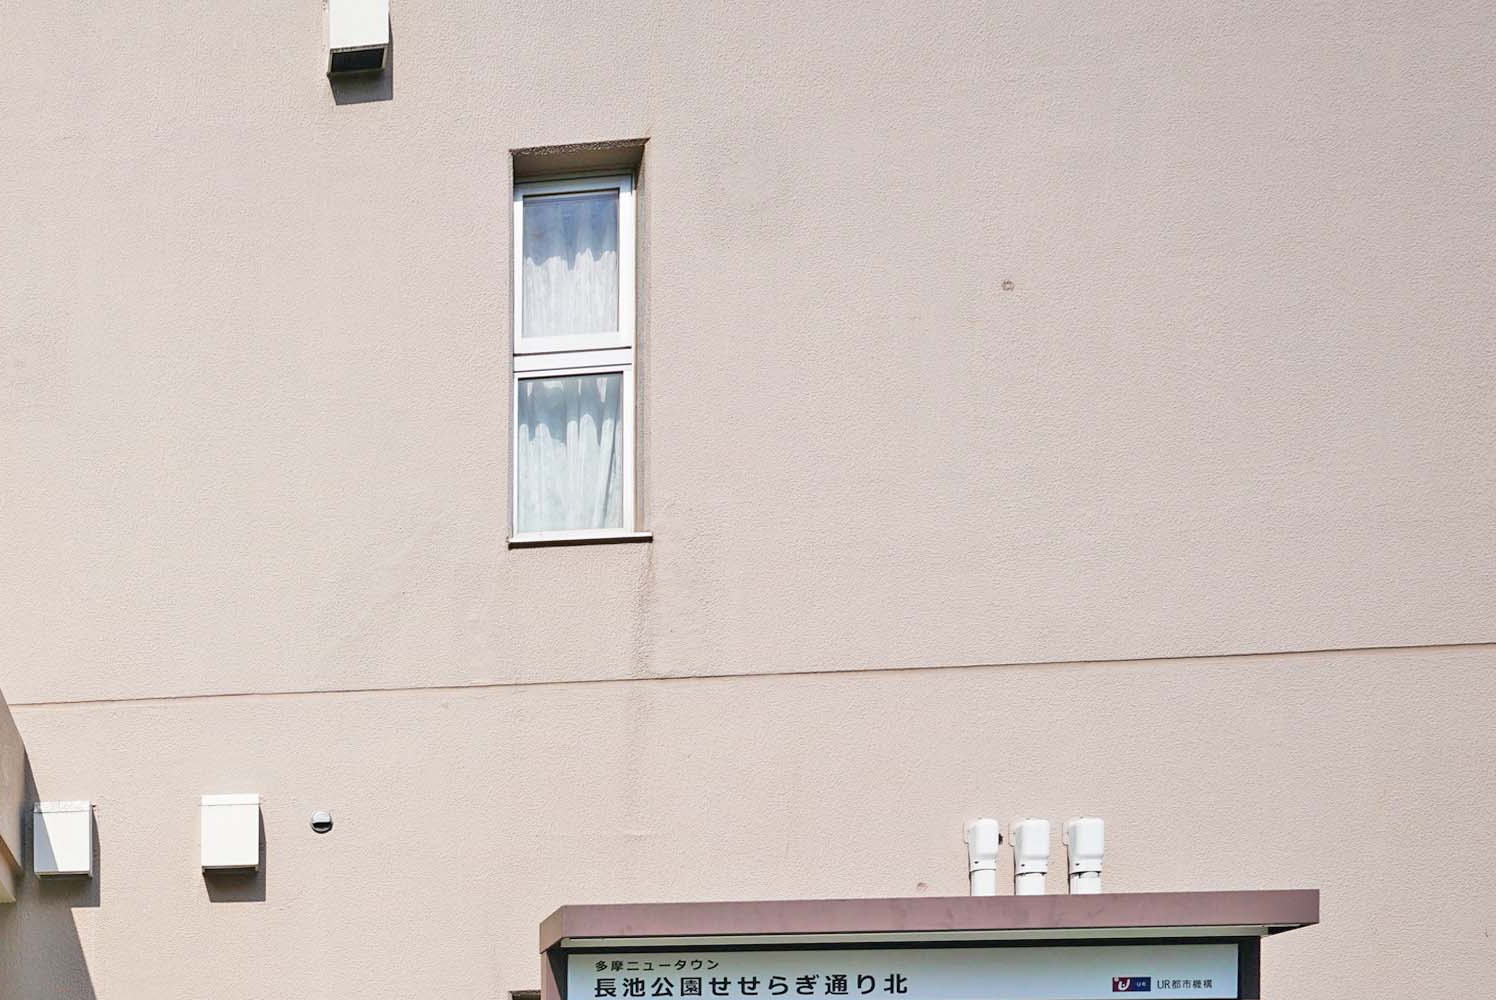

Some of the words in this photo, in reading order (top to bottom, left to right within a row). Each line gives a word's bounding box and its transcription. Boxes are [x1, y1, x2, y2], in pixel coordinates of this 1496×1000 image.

[595, 959, 720, 972] 多摩ニュータウン
[594, 973, 909, 998] 長池公園せせらぎ通り北
[1156, 979, 1213, 990] UR都市機構
